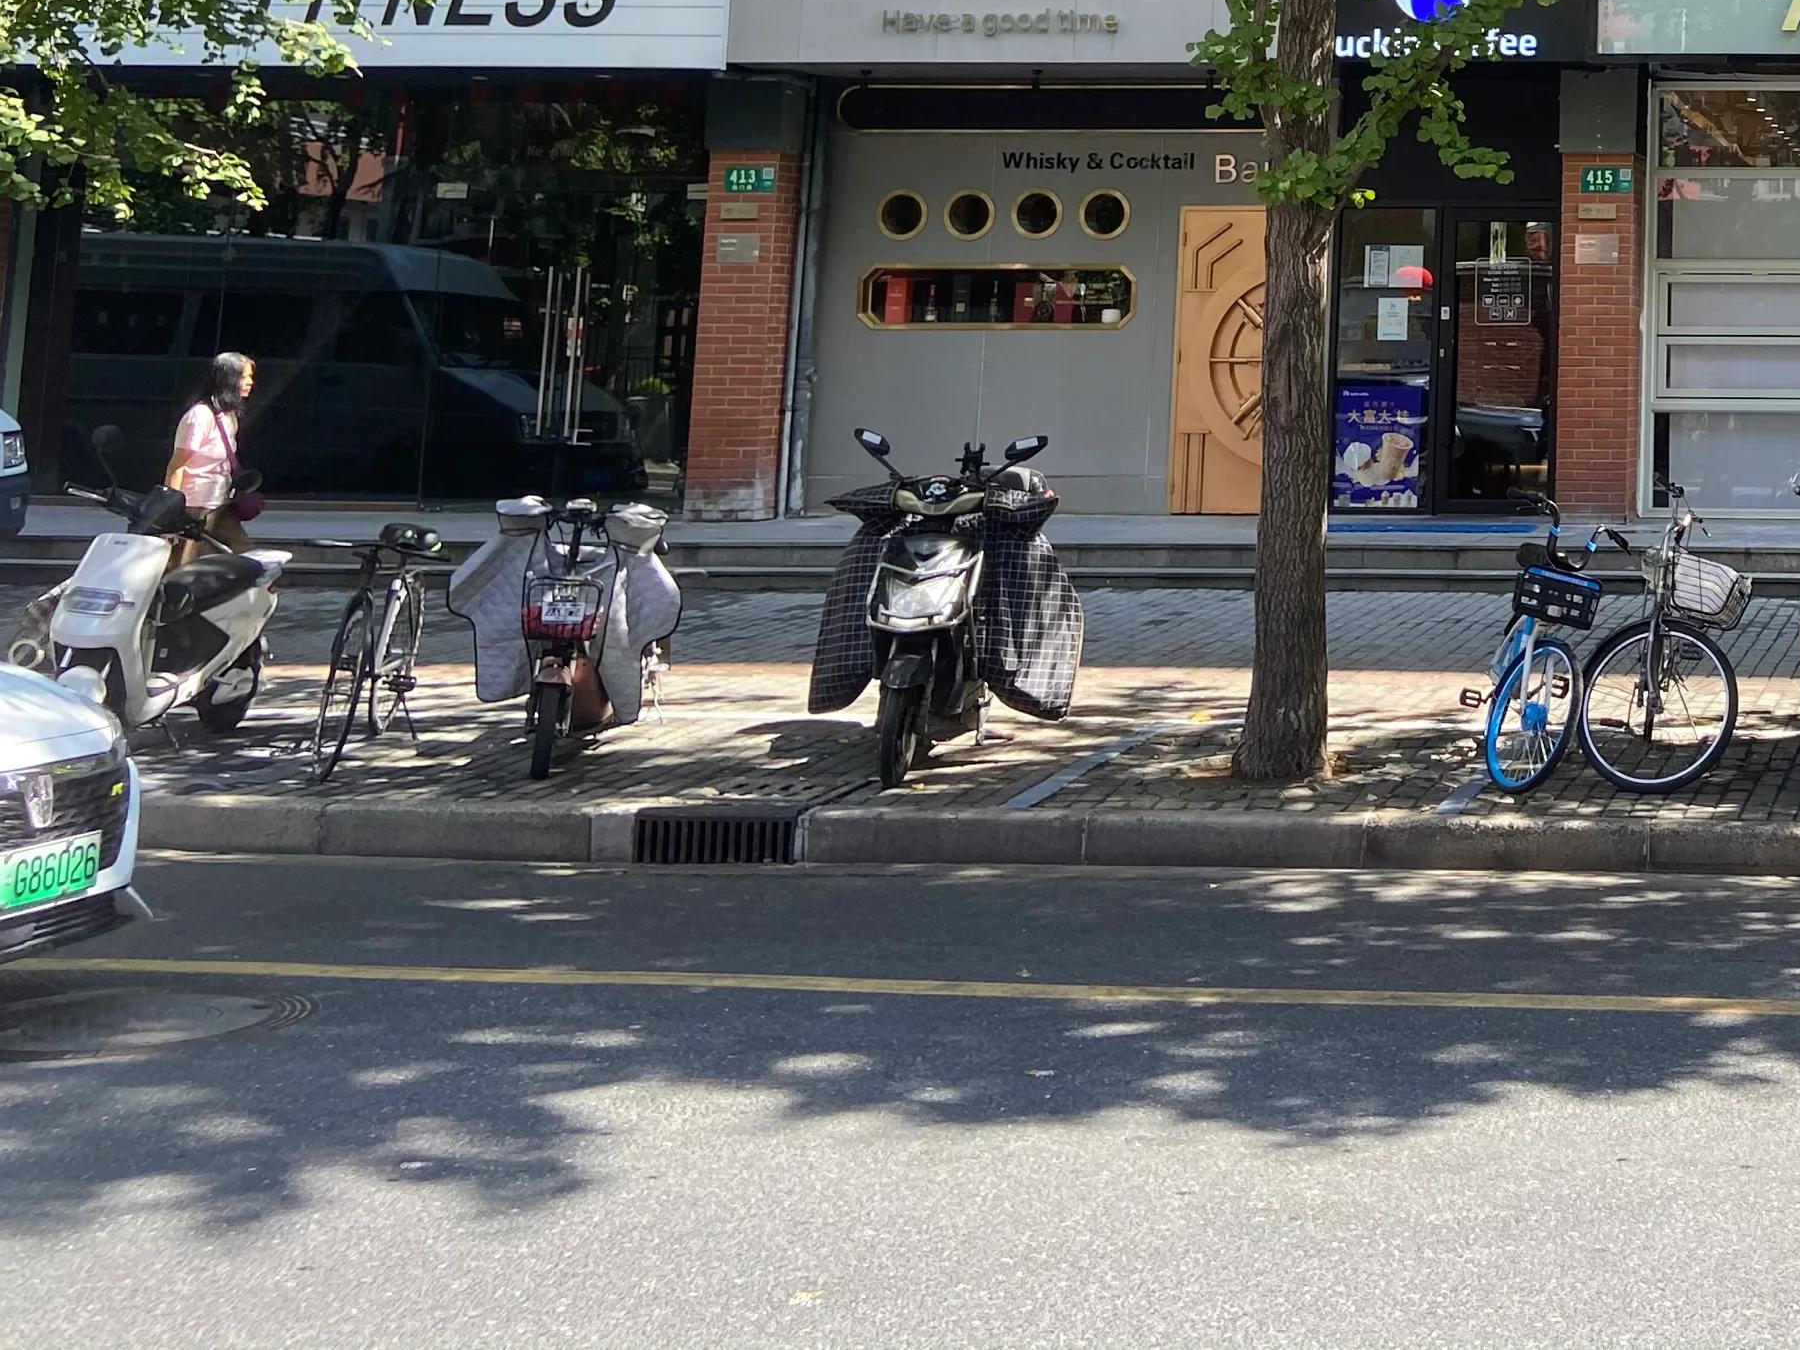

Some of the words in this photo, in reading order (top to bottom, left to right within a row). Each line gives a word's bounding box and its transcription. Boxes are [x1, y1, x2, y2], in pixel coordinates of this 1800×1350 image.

[882, 10, 951, 34] Have
[960, 13, 976, 33] a
[982, 9, 1049, 37] good
[1056, 10, 1119, 35] time
[1003, 151, 1080, 173] Whisky
[1086, 152, 1103, 170] &
[1110, 152, 1195, 170] Cocktail
[729, 169, 757, 183] 413
[1586, 170, 1613, 184] 415
[14, 842, 98, 897] G86026
